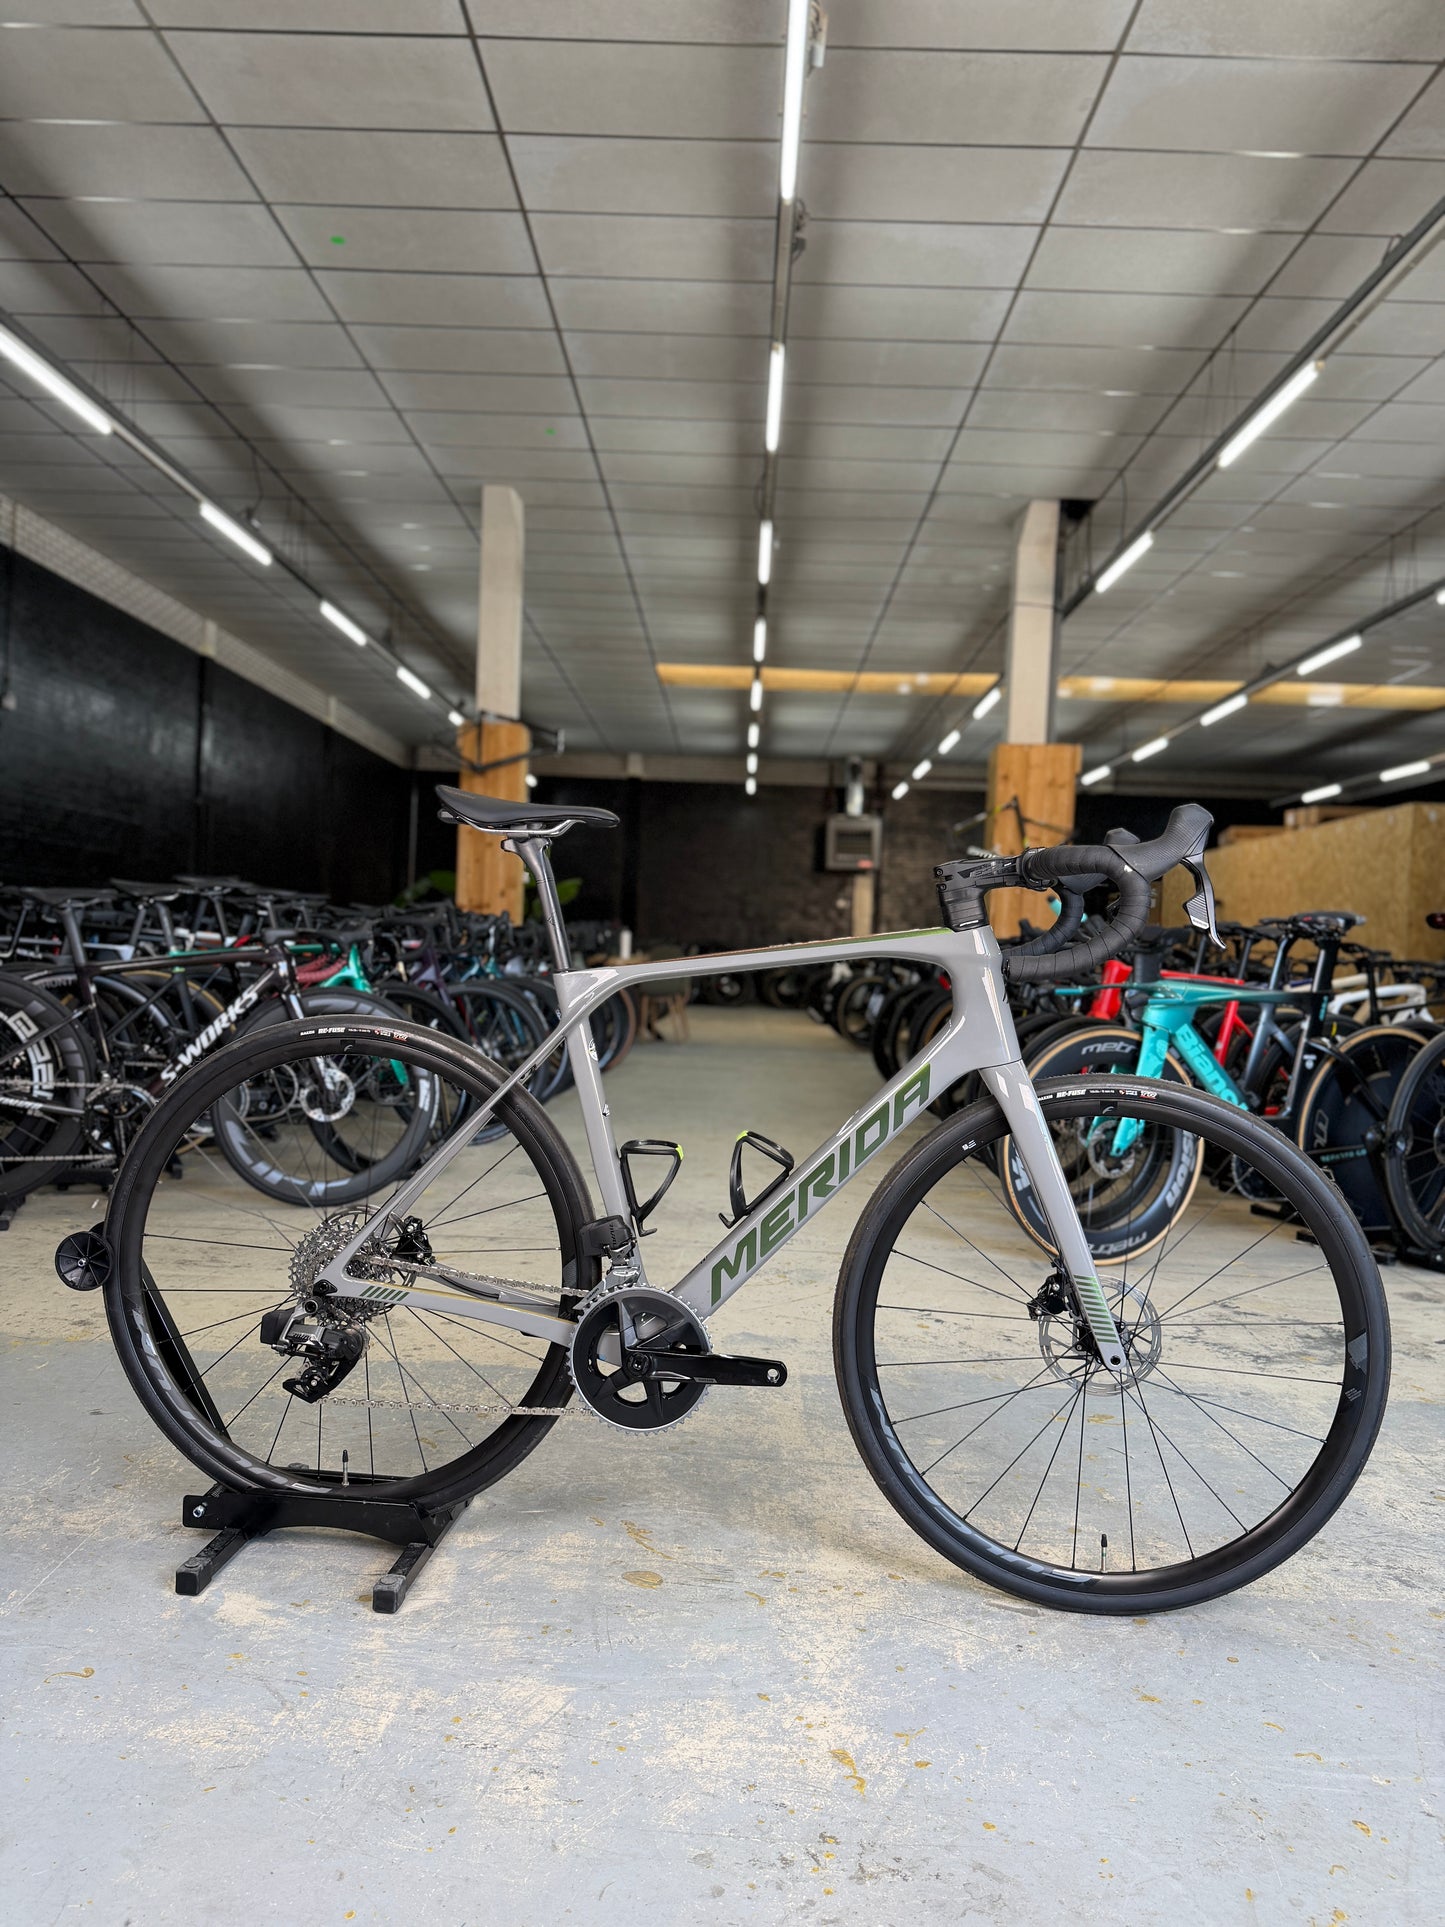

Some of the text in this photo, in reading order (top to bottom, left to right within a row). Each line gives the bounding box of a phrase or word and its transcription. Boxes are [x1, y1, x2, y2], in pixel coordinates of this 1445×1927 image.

[160, 984, 258, 1087] S-WORKS
[1081, 1041, 1137, 1056] metr
[1175, 1023, 1249, 1111] Bianc
[711, 1062, 931, 1307] MERIDA
[1165, 1129, 1198, 1209] sion
[869, 1387, 1100, 1584] FULCRUM
